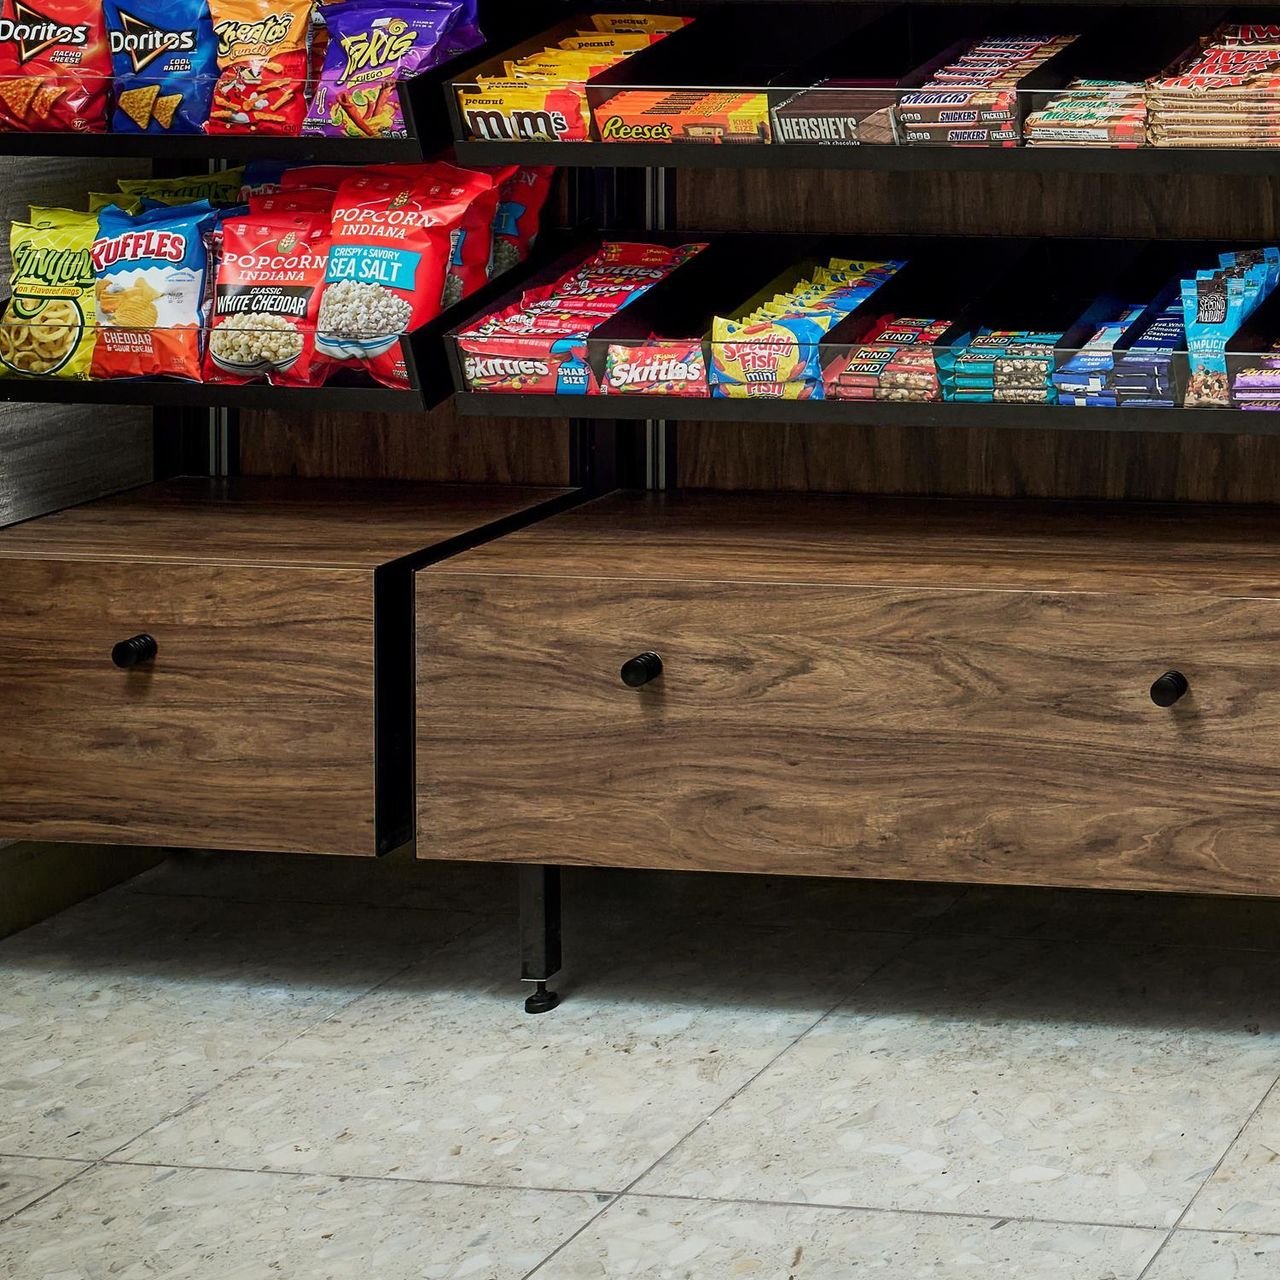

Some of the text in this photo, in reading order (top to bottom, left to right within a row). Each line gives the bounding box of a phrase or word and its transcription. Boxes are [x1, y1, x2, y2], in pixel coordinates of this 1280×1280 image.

[0, 20, 88, 43] Doritos
[111, 31, 194, 53] Doritos
[940, 112, 976, 121] SNICKERS
[603, 117, 672, 139] Reese's
[781, 118, 857, 139] HERSHEY'S
[949, 130, 986, 140] SNICKERS
[333, 208, 436, 228] POPCORN
[341, 225, 406, 240] INDIANA
[90, 232, 184, 269] RUFFLES
[222, 253, 329, 269] POPCORN
[239, 270, 305, 281] INDIANA
[329, 259, 402, 282] SEA SALT
[251, 287, 282, 295] CLASSIC
[217, 295, 307, 315] WHITE CHEDDAR
[104, 332, 152, 344] CHEDDAR
[882, 333, 914, 341] KIND
[723, 335, 793, 359] Swedish
[859, 350, 891, 359] KIND
[740, 351, 777, 370] Fish
[848, 363, 880, 371] KIND
[563, 376, 585, 384] SIZE
[746, 371, 776, 382] mini
